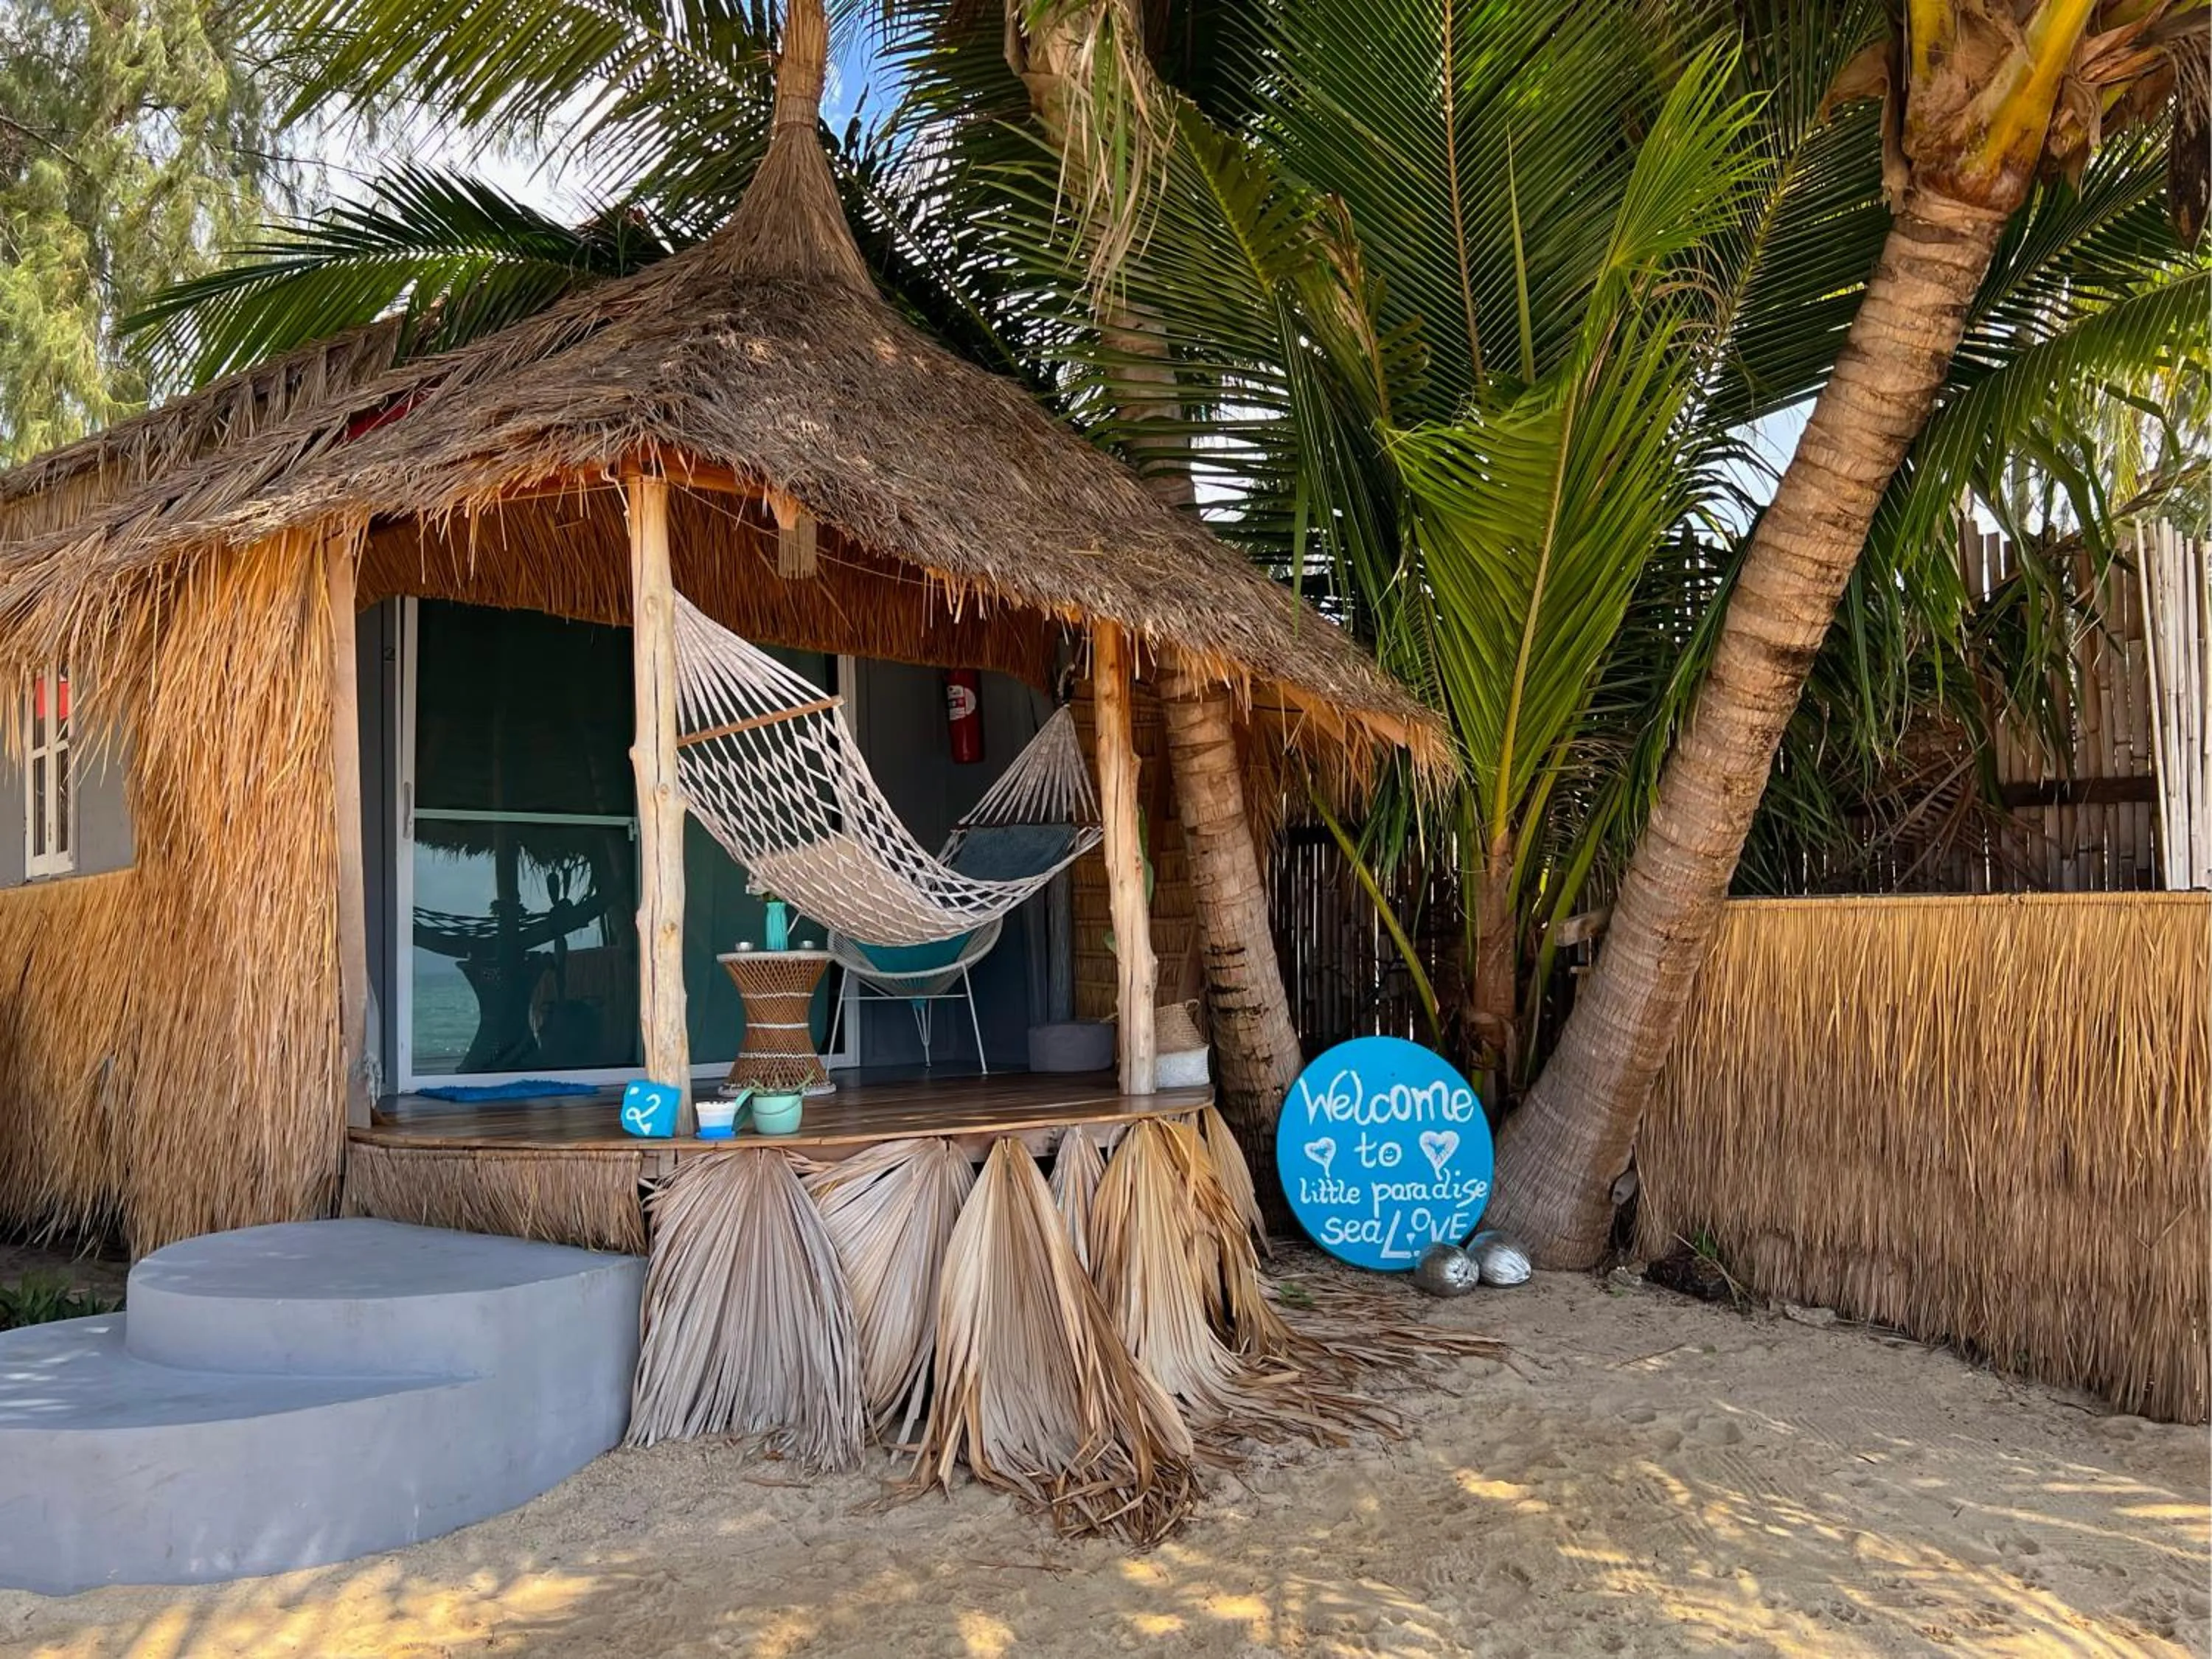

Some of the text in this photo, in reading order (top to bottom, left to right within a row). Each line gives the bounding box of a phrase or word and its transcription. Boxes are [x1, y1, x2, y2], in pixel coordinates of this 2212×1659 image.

[626, 1093, 661, 1135] 2
[1298, 1070, 1475, 1125] Welcome
[1354, 1132, 1402, 1168] to
[1299, 1168, 1487, 1218] little paradise
